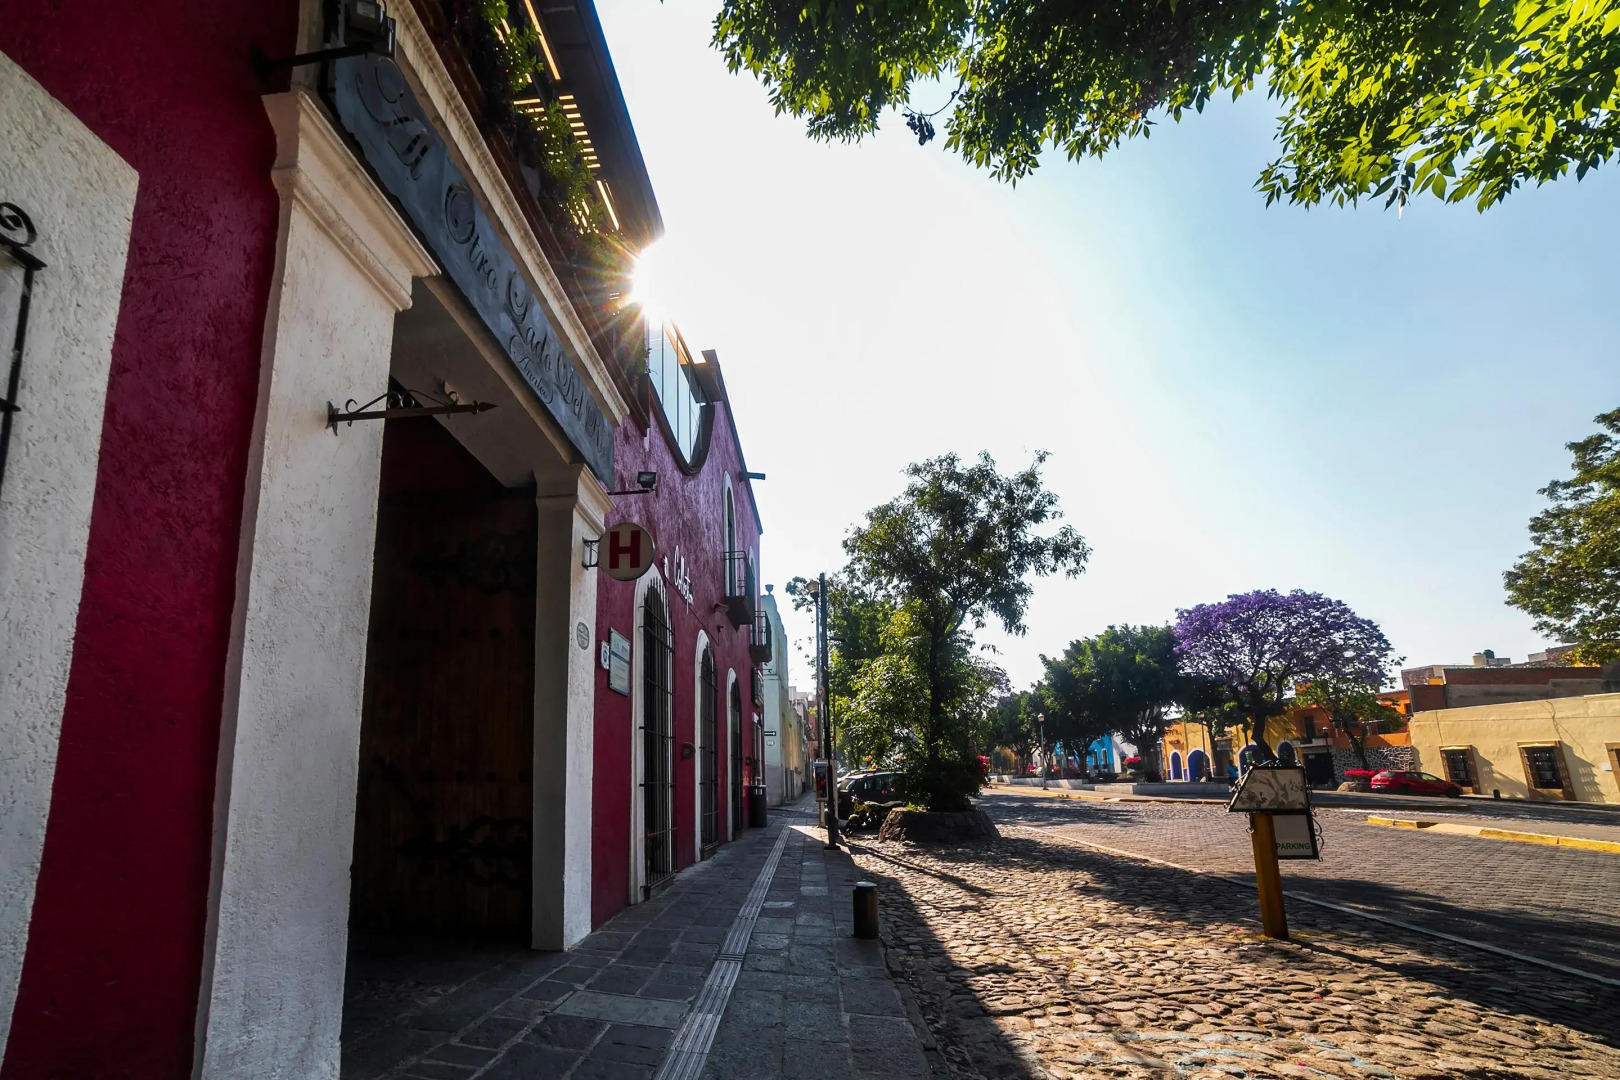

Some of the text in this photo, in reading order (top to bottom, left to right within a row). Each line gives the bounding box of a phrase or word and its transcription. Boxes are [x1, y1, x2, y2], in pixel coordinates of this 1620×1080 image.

[444, 181, 499, 291] Otro
[503, 271, 552, 373] Lado
[609, 530, 641, 570] H
